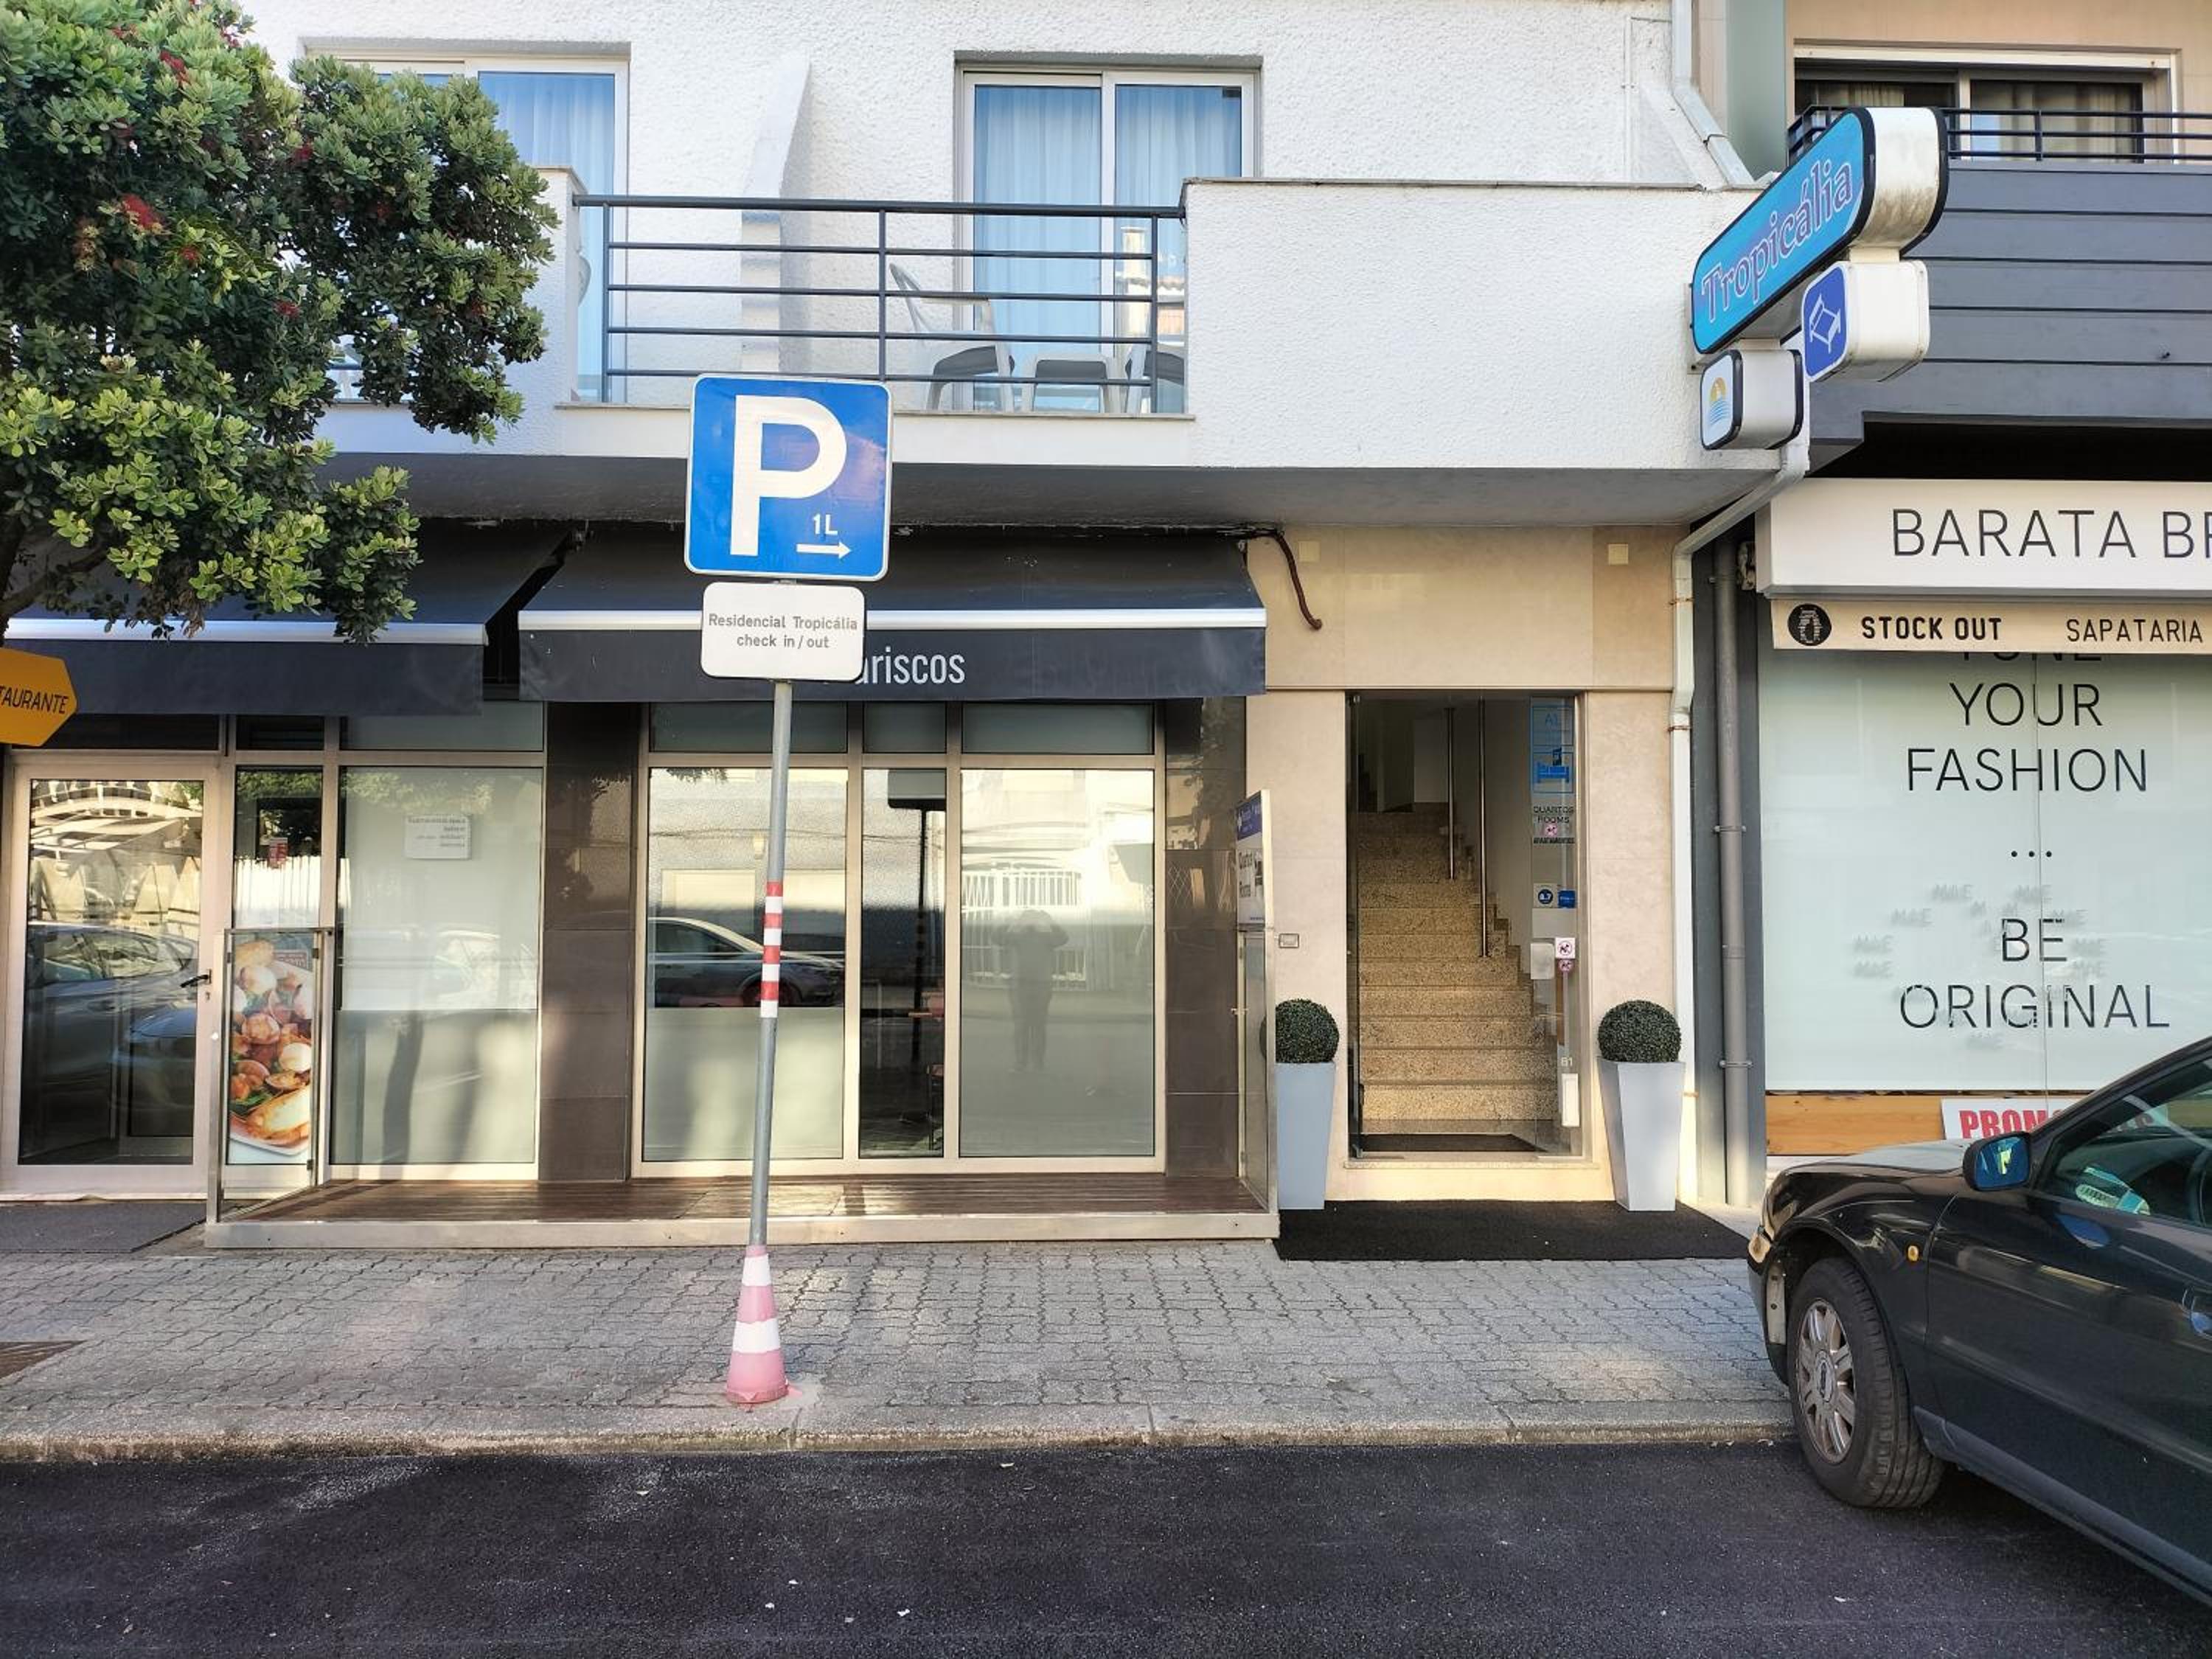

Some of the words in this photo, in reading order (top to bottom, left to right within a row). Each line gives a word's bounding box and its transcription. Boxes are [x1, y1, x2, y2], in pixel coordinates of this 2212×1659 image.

[1702, 159, 1853, 323] Tropicália
[730, 394, 847, 557] P
[813, 514, 838, 535] 1L
[1893, 509, 2136, 558] BARATA
[2163, 511, 2212, 558] B
[709, 613, 786, 628] Residencial
[793, 616, 858, 631] Tropicália
[737, 633, 777, 647] check
[1861, 616, 1943, 639] STOCK
[1955, 617, 2002, 641] OUT
[2066, 619, 2203, 642] SAPATARIA
[1949, 682, 2103, 726] YOUR
[1907, 748, 2147, 792] FASHION
[2001, 918, 2067, 961] BE
[1900, 984, 2170, 1029] ORIGINAL
